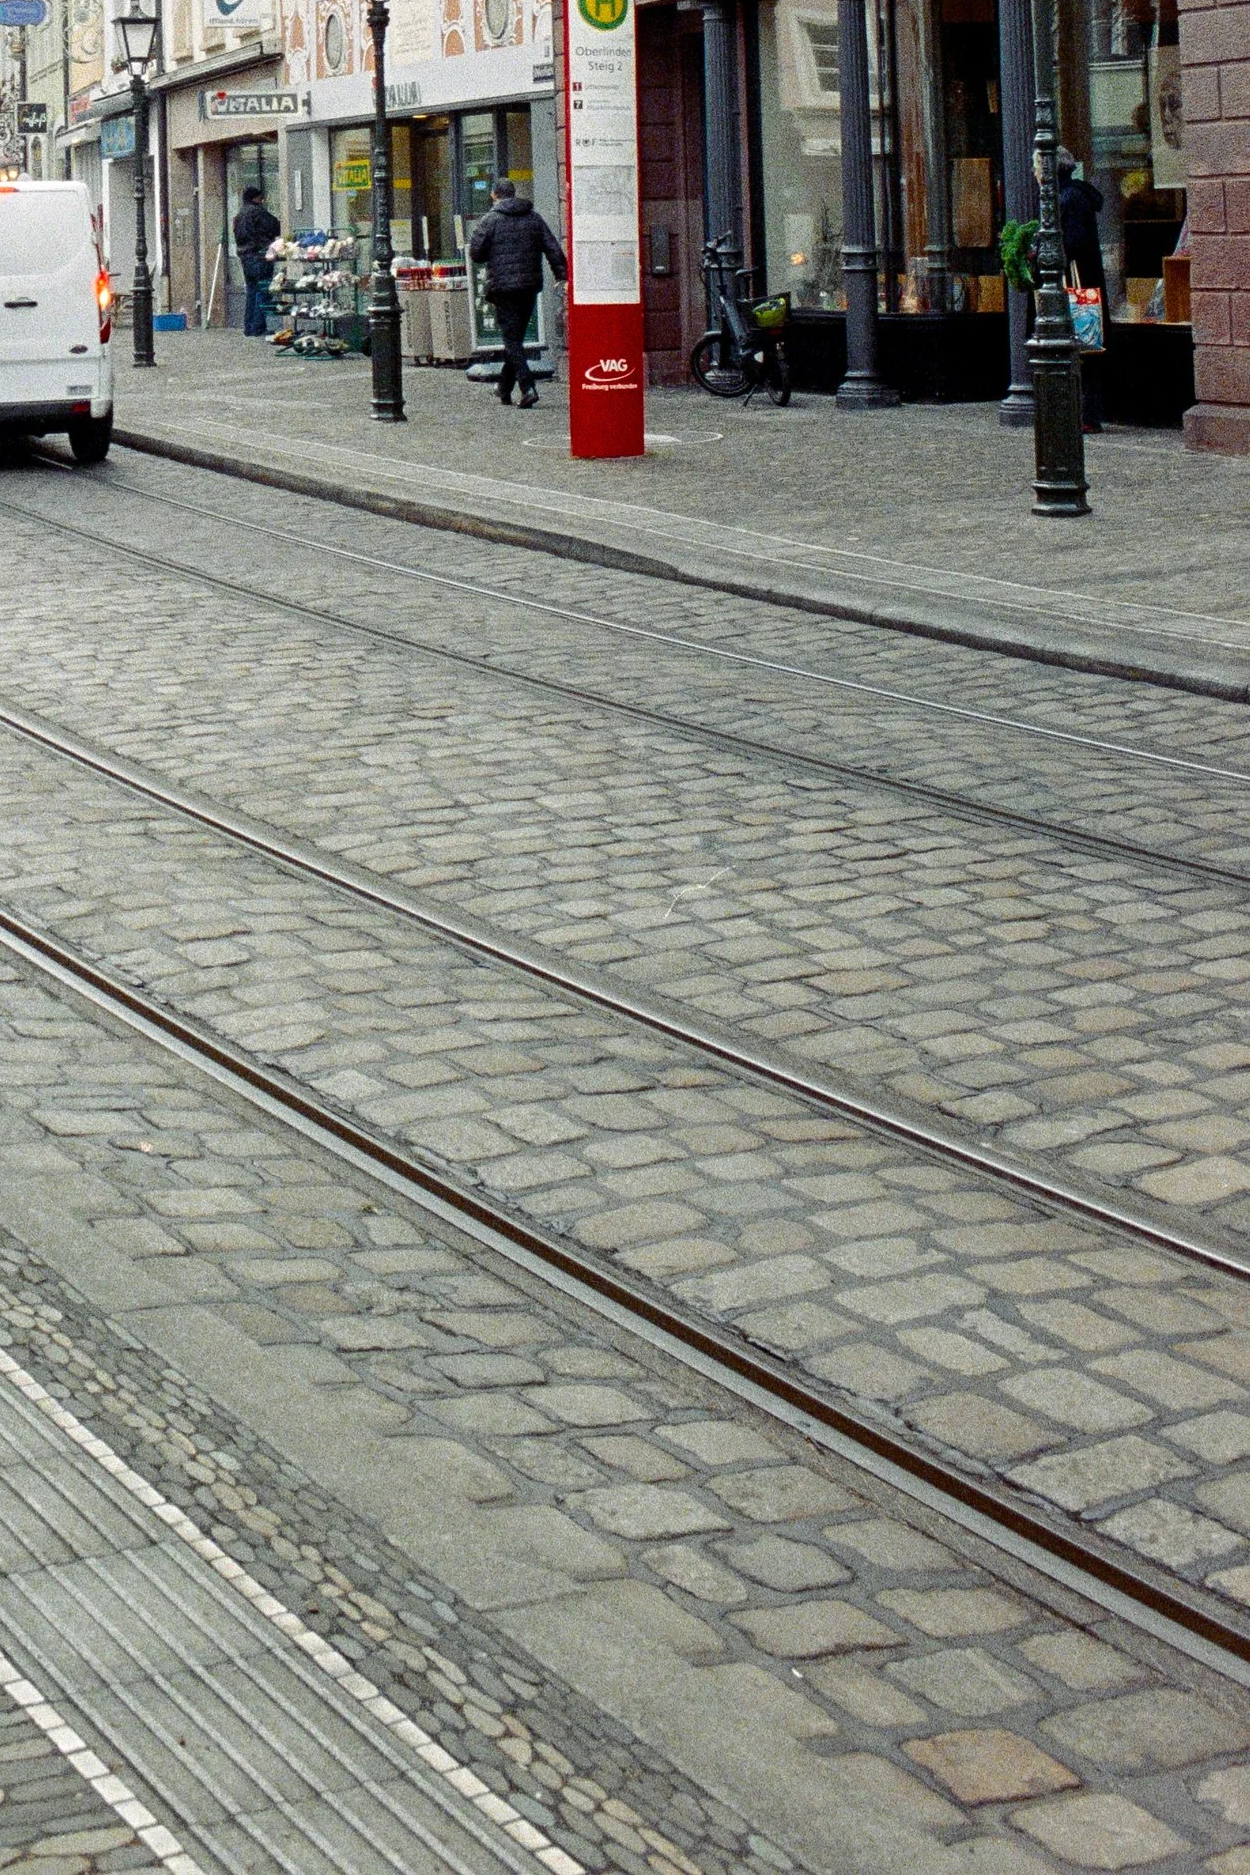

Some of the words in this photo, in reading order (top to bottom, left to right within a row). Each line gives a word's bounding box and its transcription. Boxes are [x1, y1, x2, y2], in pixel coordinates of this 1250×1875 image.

[575, 46, 632, 57] Oberlinden
[588, 61, 614, 74] Steig
[617, 62, 623, 71] 2
[600, 358, 628, 372] VAG
[581, 383, 609, 391] Freiburg
